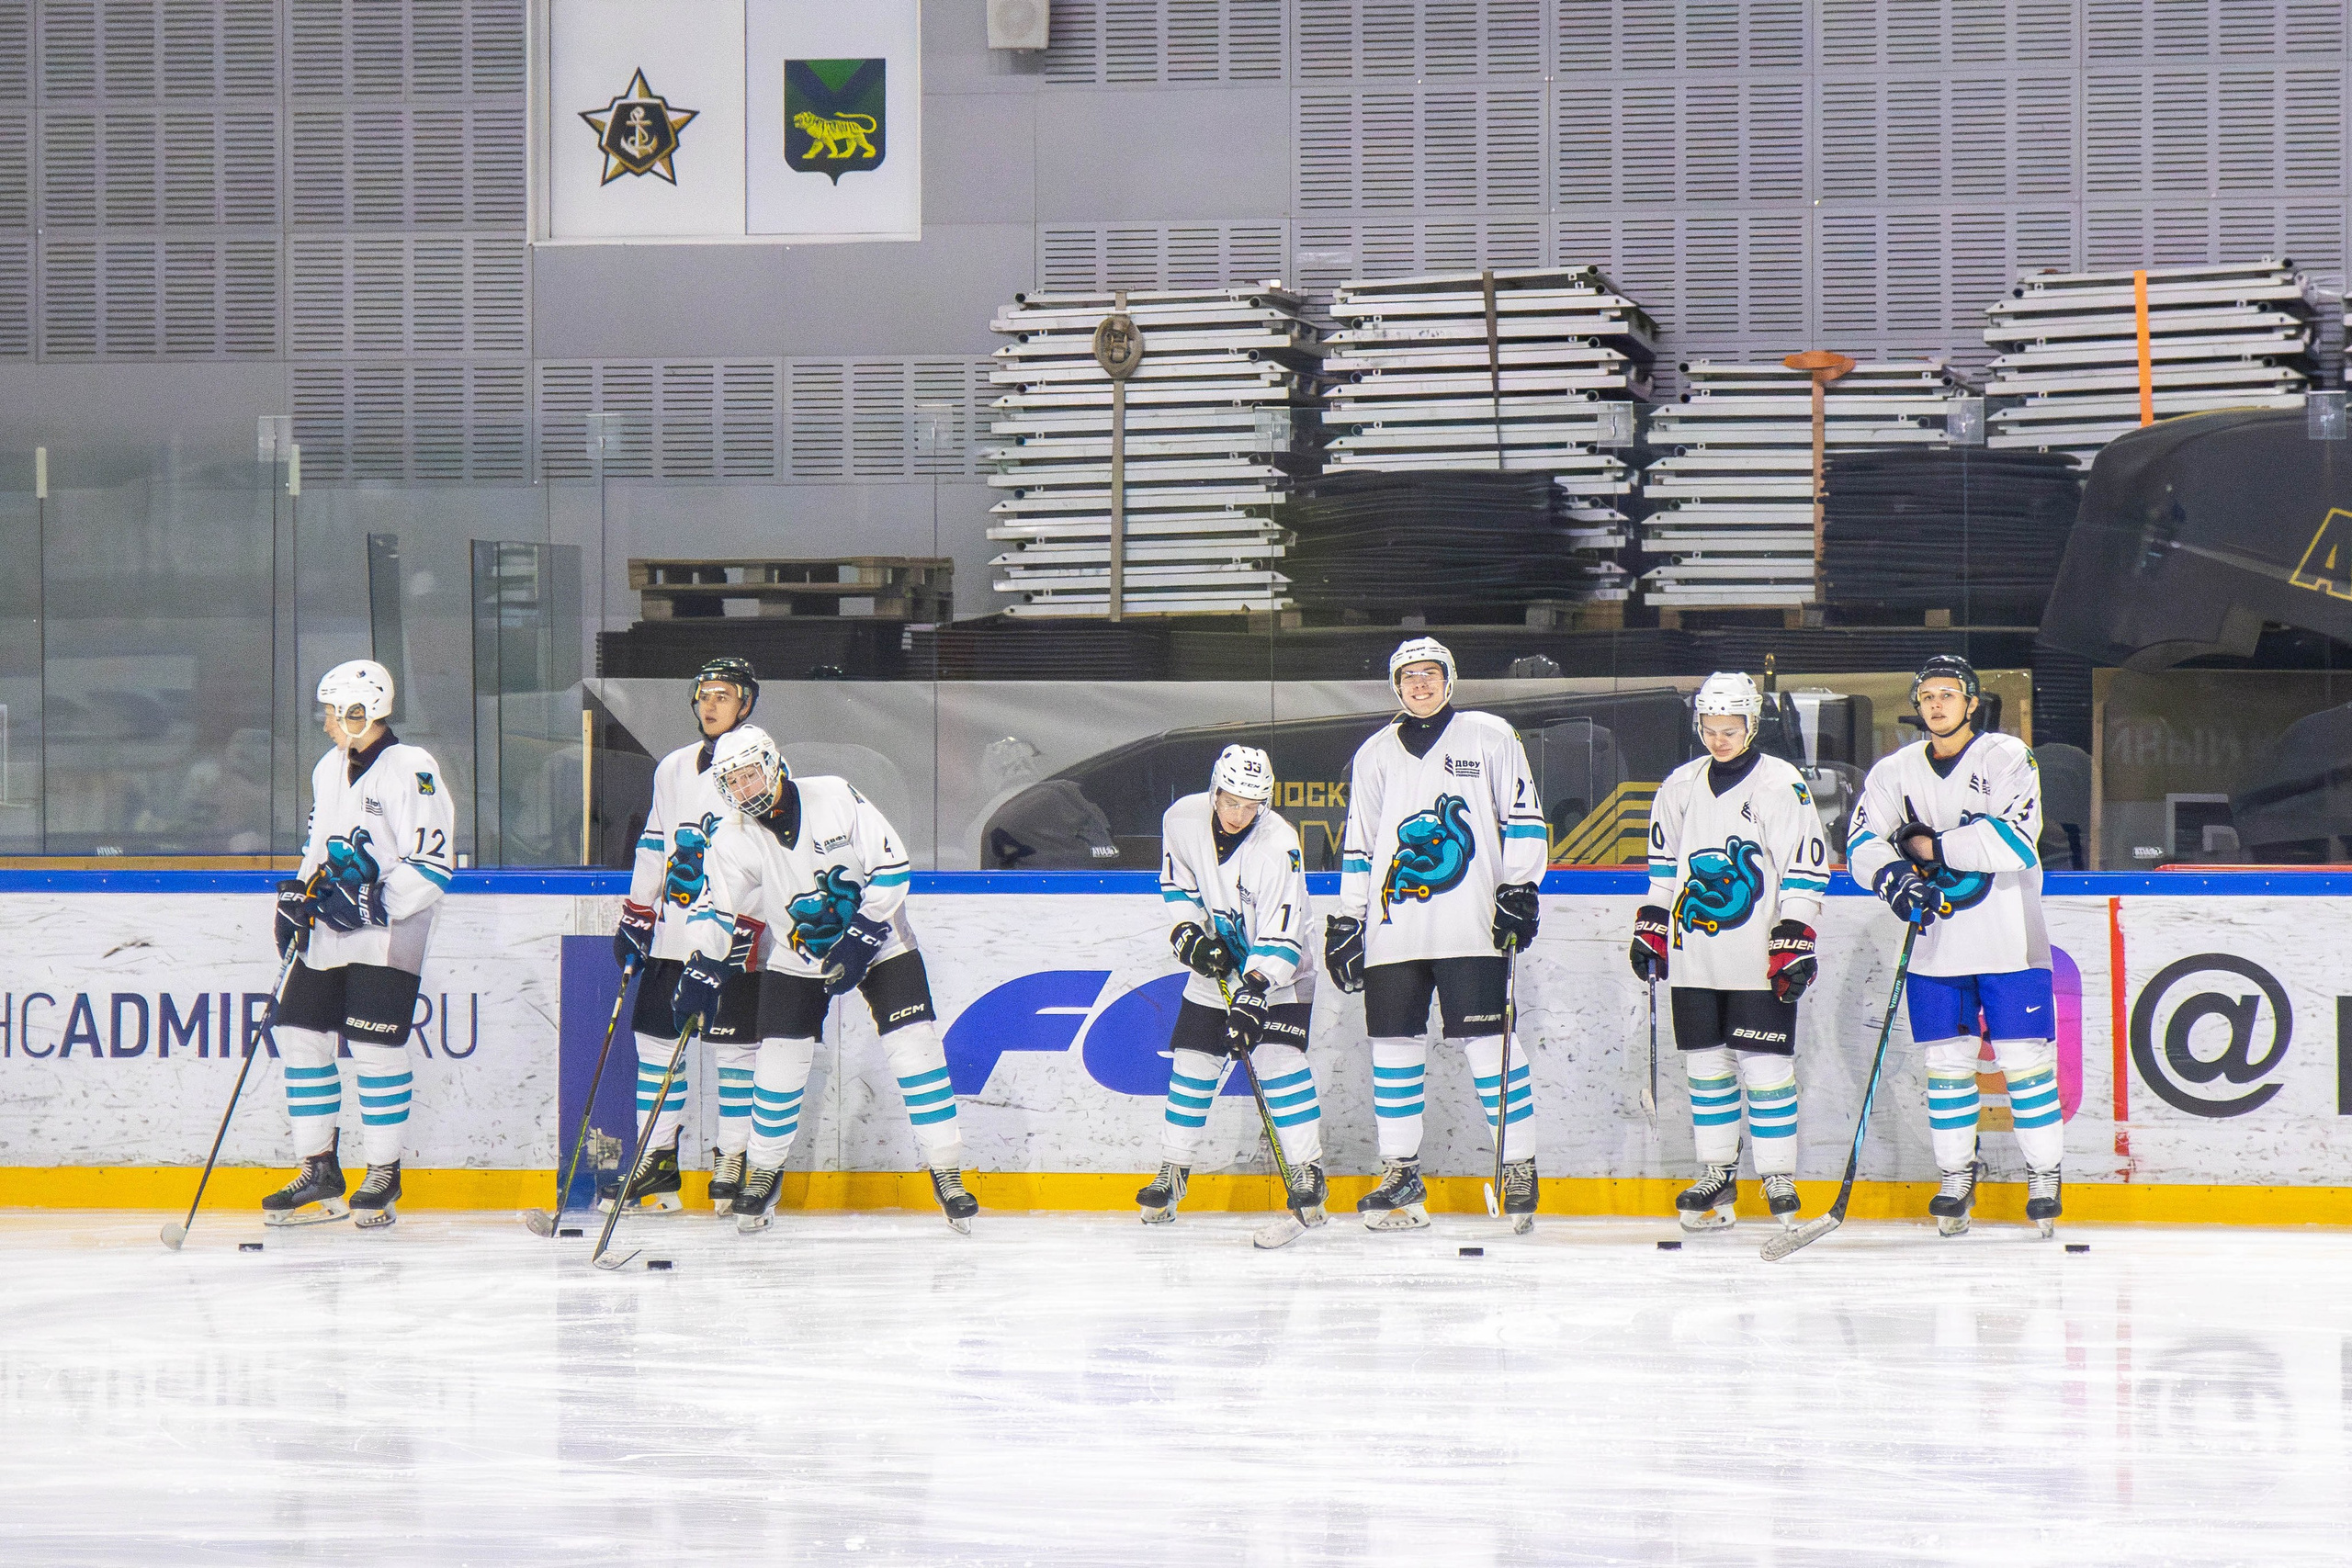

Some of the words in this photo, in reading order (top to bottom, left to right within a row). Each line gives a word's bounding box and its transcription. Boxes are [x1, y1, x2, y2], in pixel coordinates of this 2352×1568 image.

[1243, 760, 1262, 773] 33
[1454, 760, 1481, 768] ДВФУ
[1513, 777, 1539, 809] 21
[415, 827, 447, 859] 12
[1795, 836, 1826, 867] 10
[888, 1003, 925, 1023] CCM
